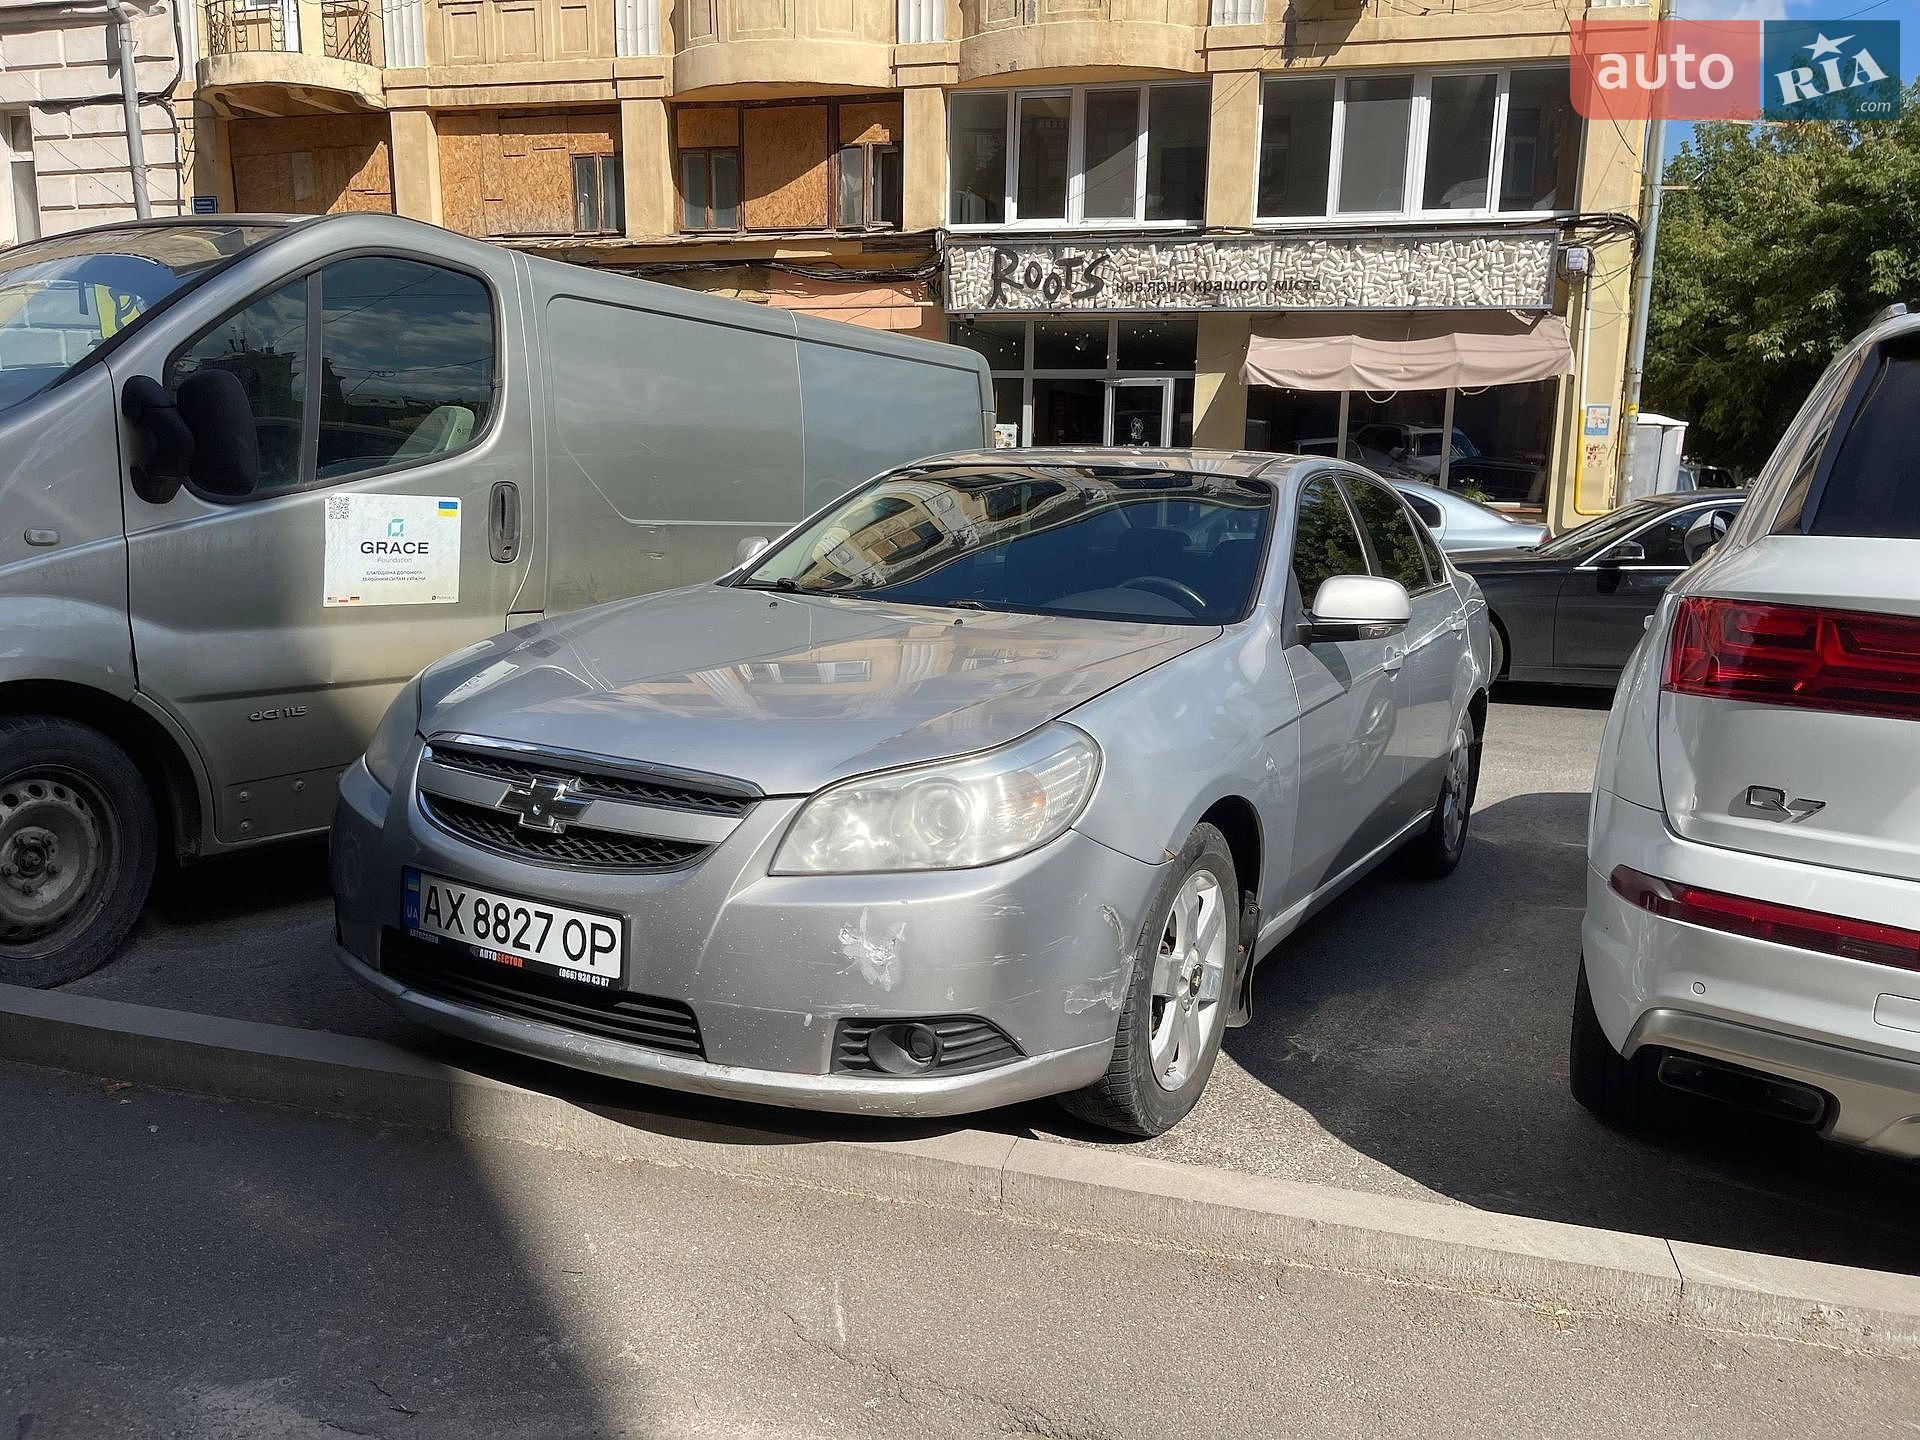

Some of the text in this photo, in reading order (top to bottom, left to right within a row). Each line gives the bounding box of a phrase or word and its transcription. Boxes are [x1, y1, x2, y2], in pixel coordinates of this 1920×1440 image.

[1193, 279, 1268, 294] кращого
[1273, 276, 1321, 292] міста
[360, 541, 429, 555] GRACE
[1745, 784, 1826, 823] Q7
[406, 905, 419, 919] UA
[423, 885, 617, 966] AX 8827 OP
